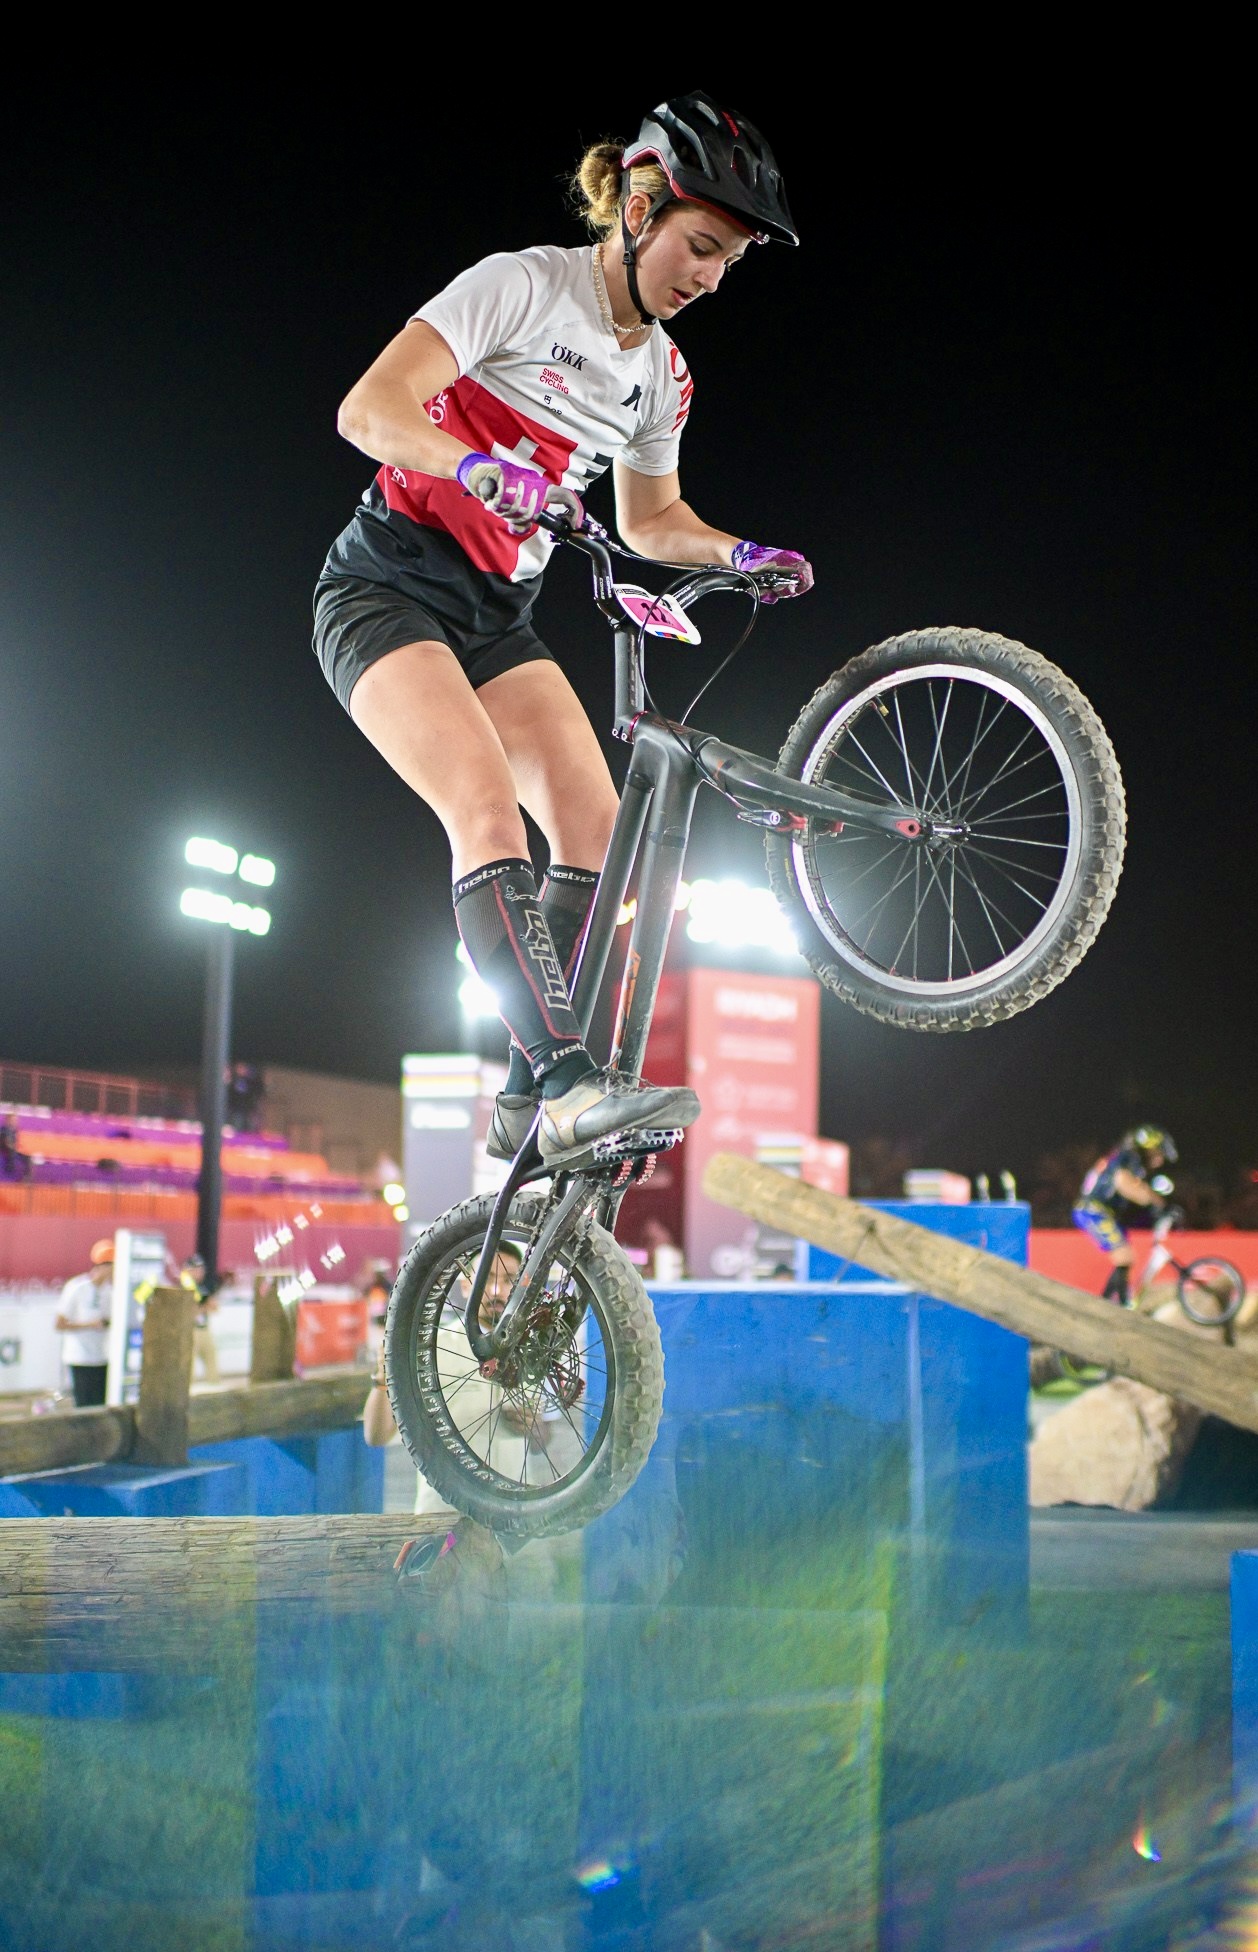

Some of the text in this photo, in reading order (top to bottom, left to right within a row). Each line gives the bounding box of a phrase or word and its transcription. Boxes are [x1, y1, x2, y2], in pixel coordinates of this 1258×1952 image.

[551, 342, 588, 371] ÖKK
[539, 375, 570, 395] CYCLING
[542, 368, 564, 384] SWISS
[458, 866, 510, 894] hebo
[550, 869, 596, 883] hebo
[551, 1043, 586, 1061] heb
